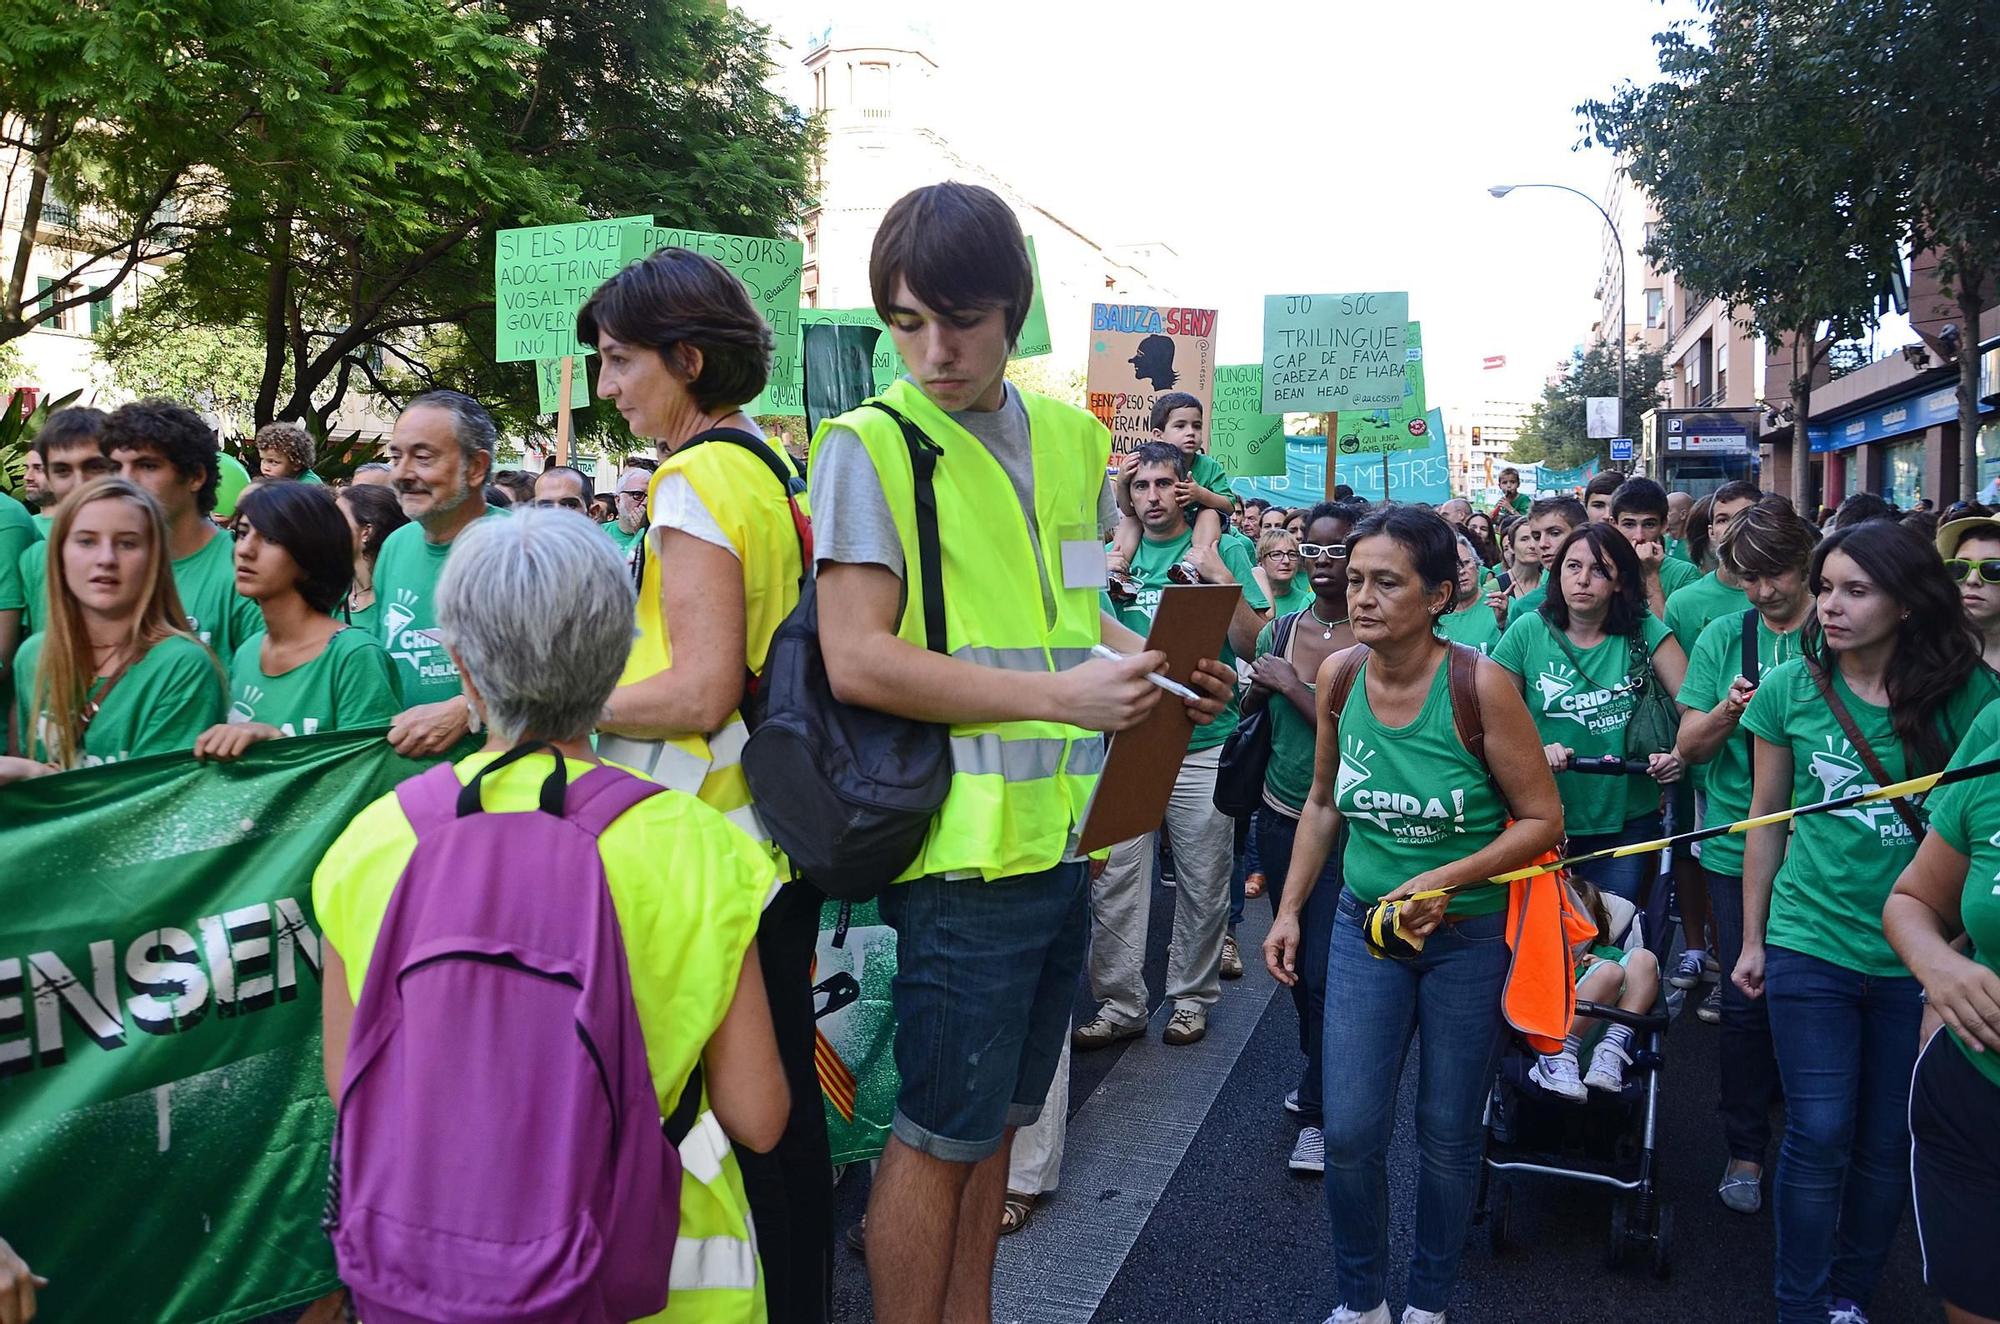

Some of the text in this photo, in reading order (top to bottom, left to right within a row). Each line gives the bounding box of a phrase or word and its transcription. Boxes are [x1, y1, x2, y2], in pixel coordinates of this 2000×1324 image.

[500, 234, 520, 260] SI
[531, 230, 566, 258] ELS
[1285, 292, 1379, 316] JO SÓC
[1166, 307, 1217, 338] SENY
[514, 328, 592, 357] INÚTIL
[1272, 349, 1390, 369] CAP DE FAVA
[1272, 363, 1407, 386] CABEZA DE HABA
[1223, 386, 1258, 398] CAMPS
[1273, 384, 1349, 401] BEAN HEAD
[1670, 420, 1680, 431] P
[1612, 441, 1632, 450] VAP
[1354, 455, 1449, 491] MESTRES
[1352, 788, 1465, 833] CRIDA!
[1881, 838, 1895, 847] DE
